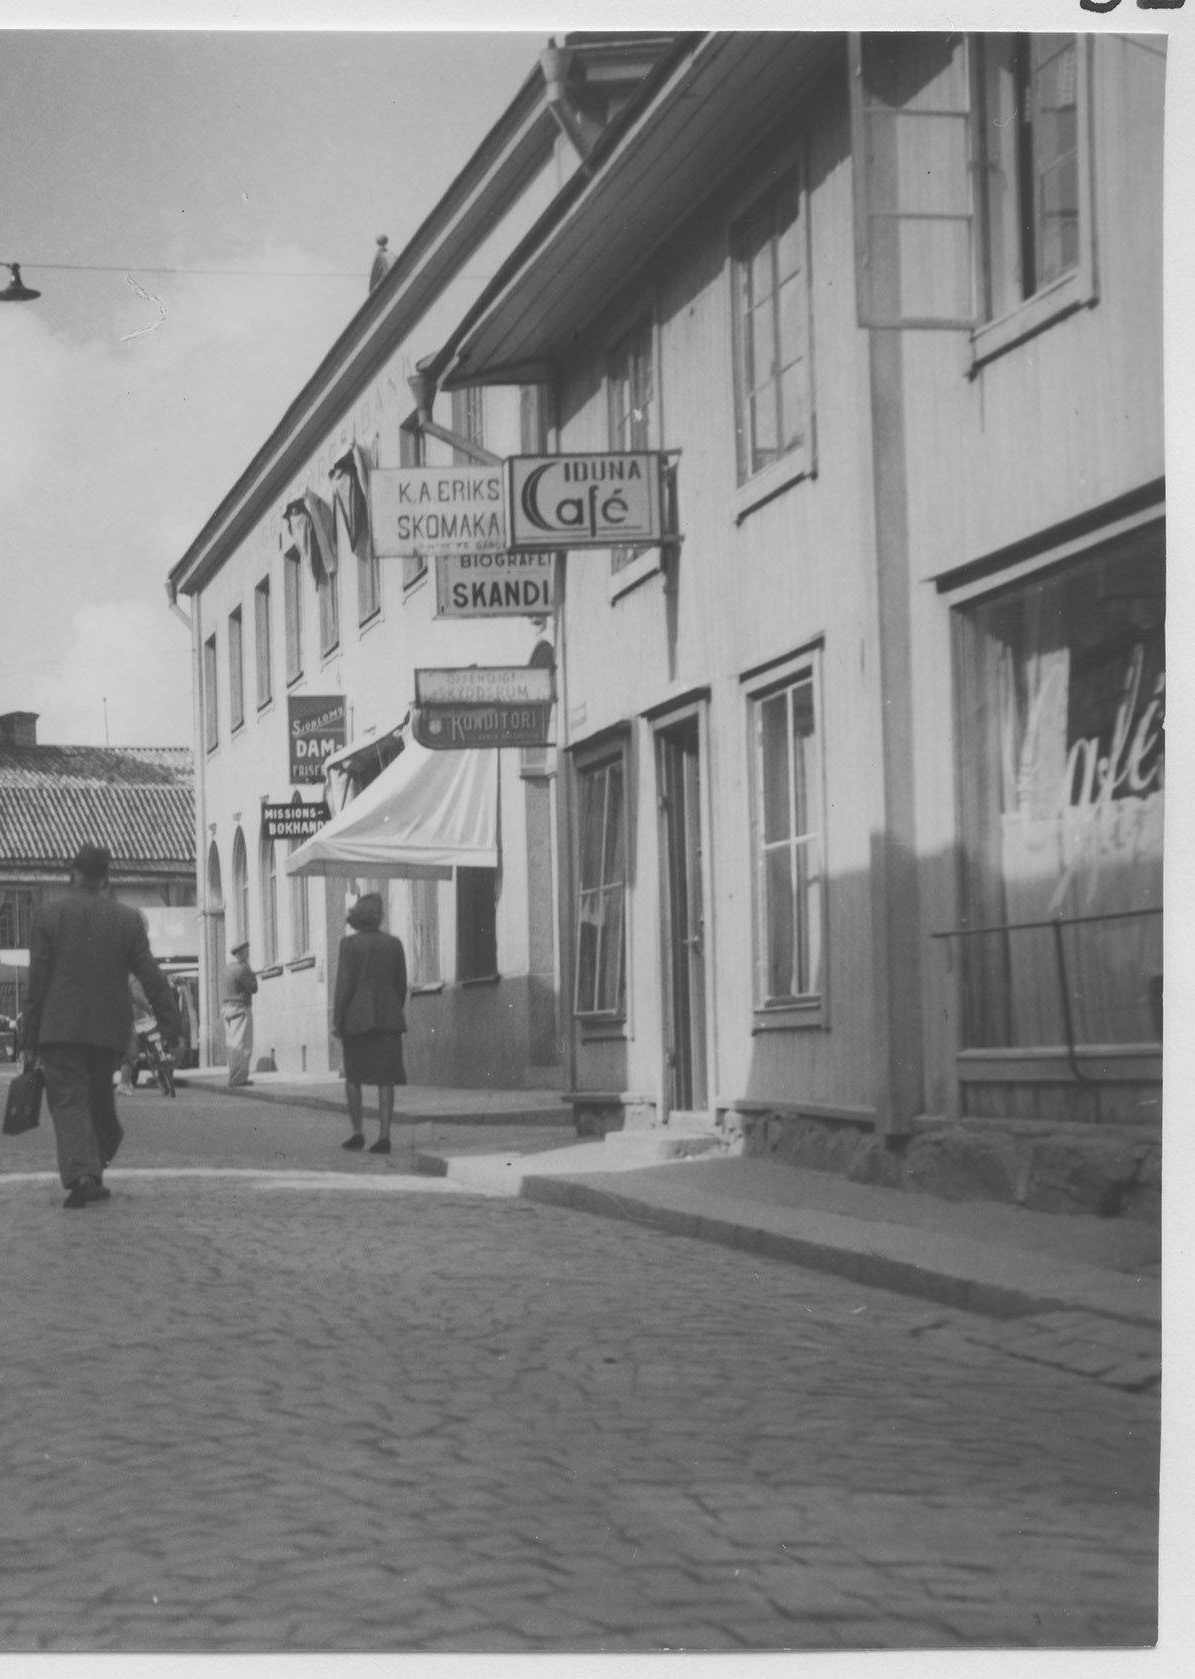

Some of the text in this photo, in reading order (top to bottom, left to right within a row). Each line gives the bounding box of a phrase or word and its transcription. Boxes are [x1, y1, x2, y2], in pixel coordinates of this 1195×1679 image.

[564, 460, 642, 483] IDUNA
[438, 477, 500, 502] ERIKS
[520, 461, 630, 539] Café
[397, 511, 501, 540] SKOMAKA
[453, 579, 549, 608] SKANDI
[264, 807, 324, 820] MISSIONS-
